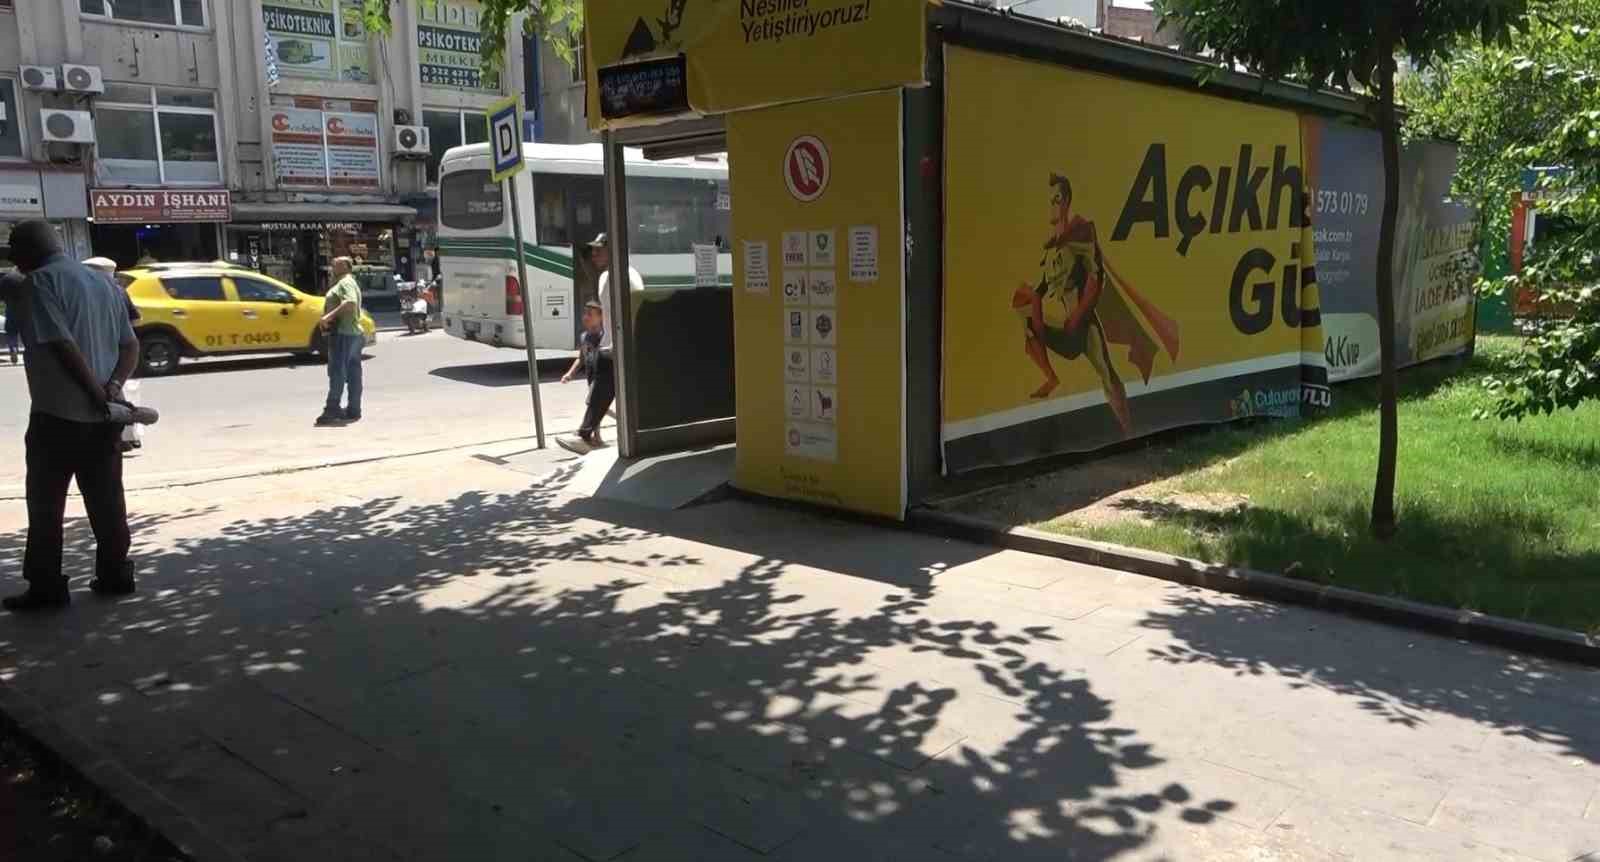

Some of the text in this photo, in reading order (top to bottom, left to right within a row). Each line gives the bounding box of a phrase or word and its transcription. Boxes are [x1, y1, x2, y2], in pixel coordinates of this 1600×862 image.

[741, 0, 870, 43] Yetiştiriyoruz!
[419, 28, 481, 53] PSİKOTEKN
[500, 124, 513, 156] D
[95, 190, 227, 209] AYDIN İŞHANI
[1110, 143, 1312, 256] Açıkh
[1317, 189, 1337, 213] 573
[206, 334, 224, 347] 01
[231, 332, 240, 345] T
